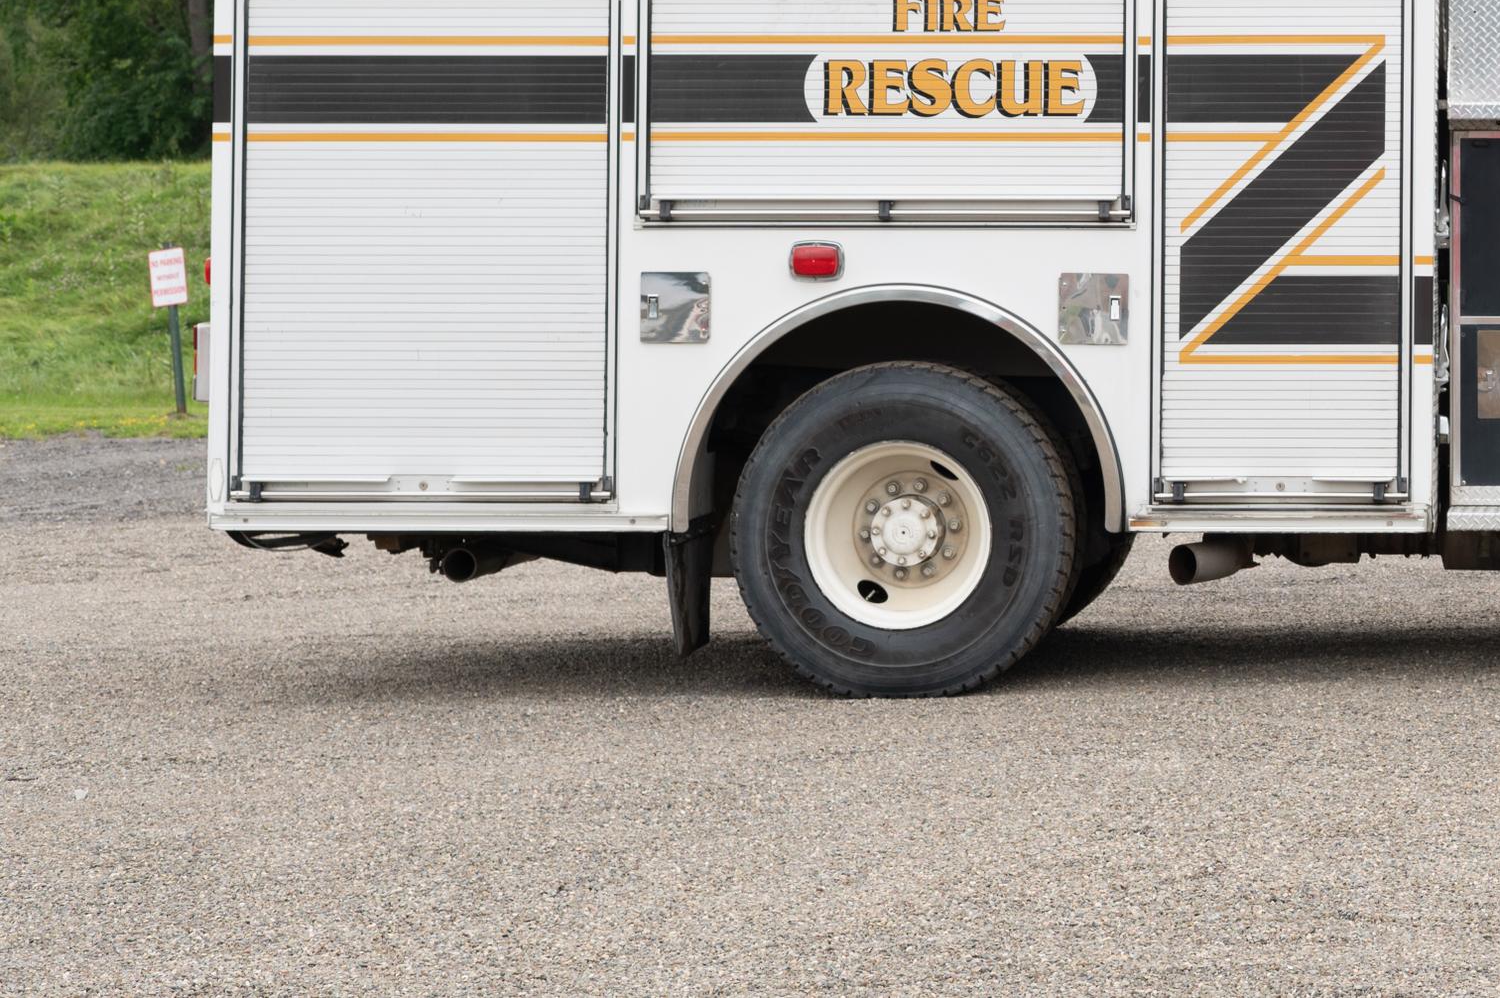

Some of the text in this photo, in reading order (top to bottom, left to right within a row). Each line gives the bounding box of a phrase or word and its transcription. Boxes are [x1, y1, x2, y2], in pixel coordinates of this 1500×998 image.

[823, 58, 1086, 118] RESCUE
[767, 446, 876, 657] GOODYEAR
[1002, 518, 1026, 588] RSD
